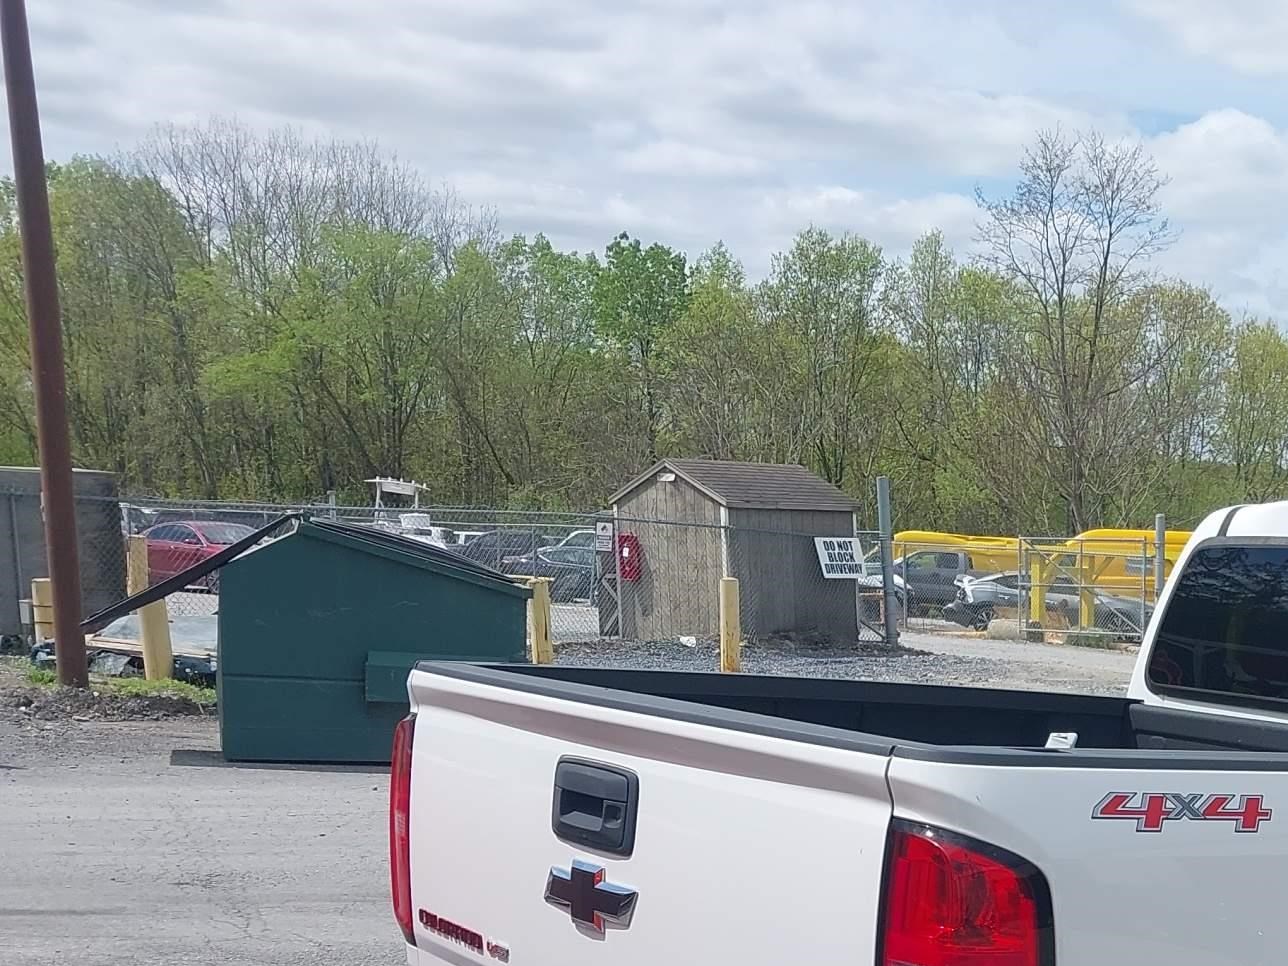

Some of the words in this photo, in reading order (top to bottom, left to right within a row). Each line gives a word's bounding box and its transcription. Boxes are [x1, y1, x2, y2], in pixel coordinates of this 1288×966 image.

[823, 540, 836, 551] DO
[836, 540, 854, 551] NOT
[827, 551, 856, 562] BLOCK
[824, 563, 863, 574] DRIVEWAY
